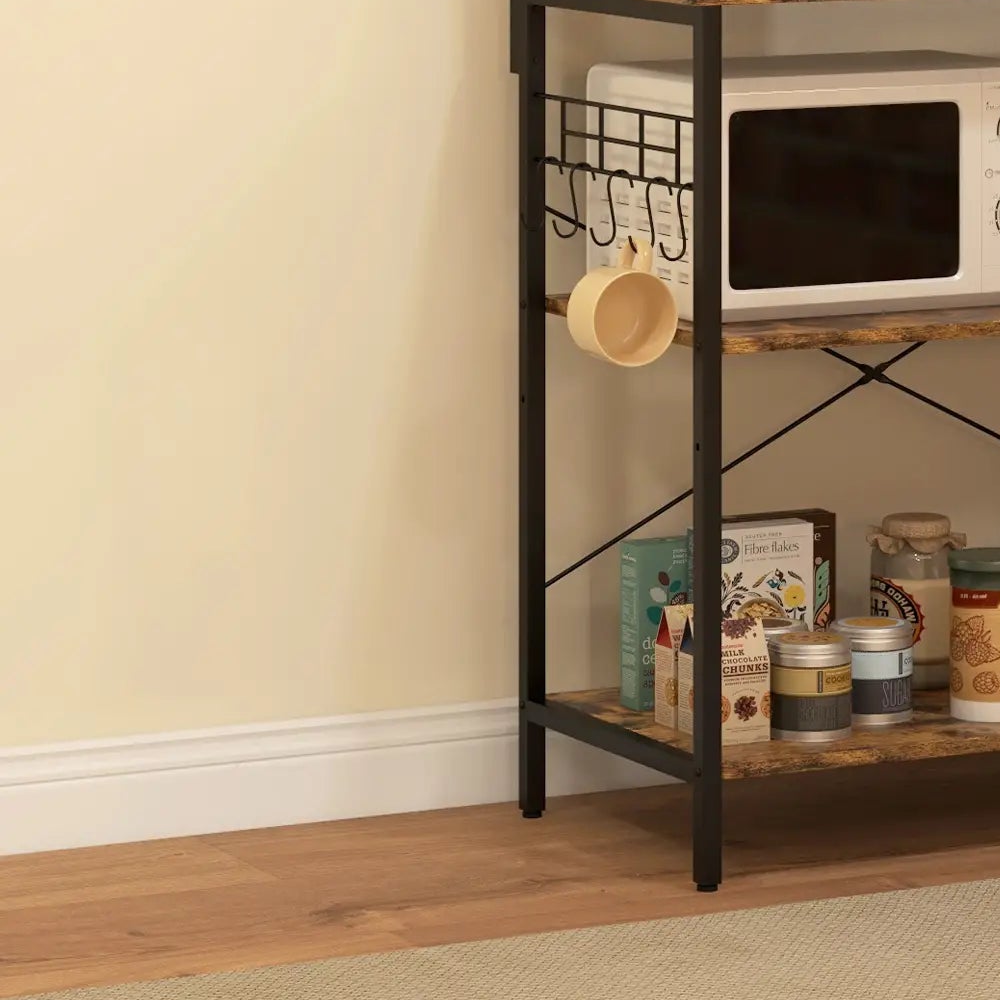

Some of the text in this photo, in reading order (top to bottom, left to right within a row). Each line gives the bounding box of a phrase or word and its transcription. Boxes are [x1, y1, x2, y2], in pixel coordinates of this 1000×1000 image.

[744, 543, 769, 555] Fibre
[771, 540, 800, 553] flakes
[721, 649, 745, 658] MILK
[721, 655, 769, 665] CHOCOLATE
[722, 663, 769, 675] CHUNKS
